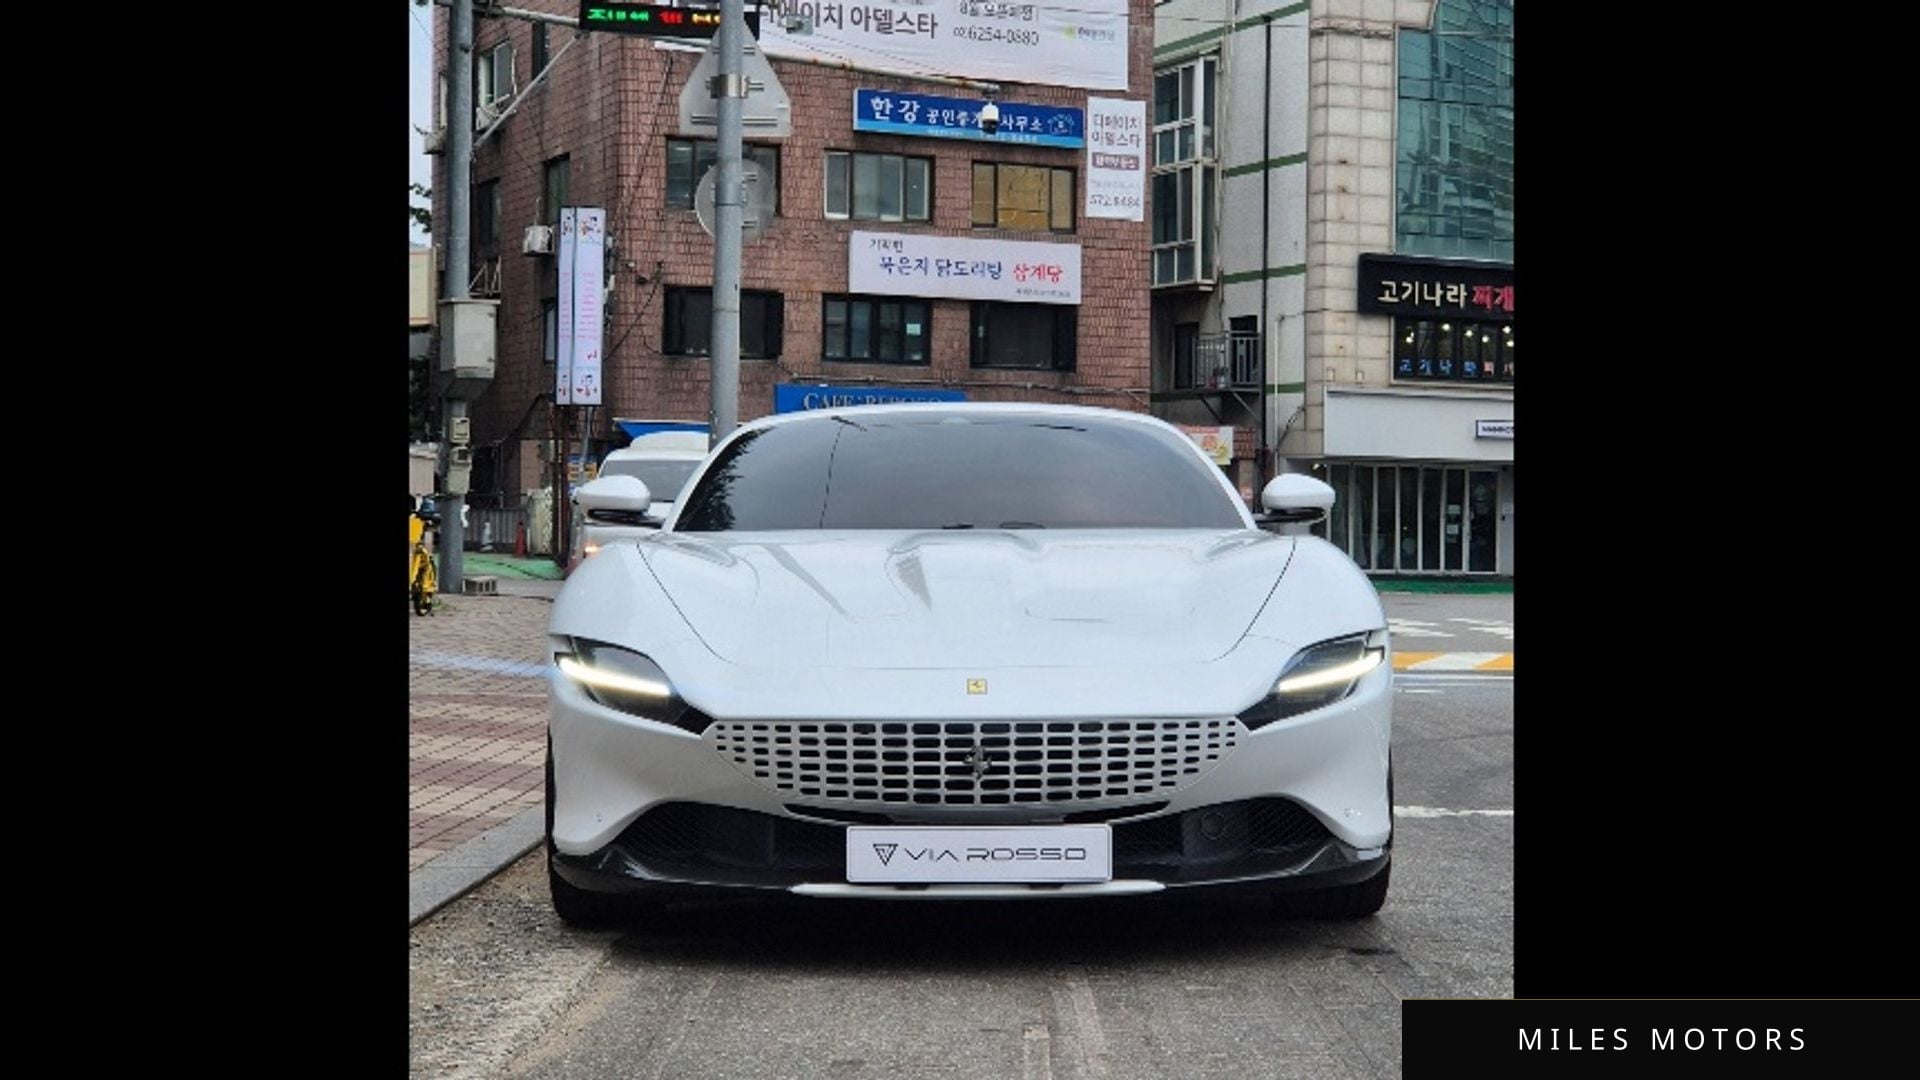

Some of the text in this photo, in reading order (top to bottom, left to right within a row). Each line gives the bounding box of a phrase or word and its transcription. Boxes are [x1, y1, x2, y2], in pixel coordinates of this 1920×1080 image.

[850, 5, 939, 39] 아델스타
[926, 108, 1044, 133] 공인중개사무소
[1377, 280, 1467, 309] 고기나라
[904, 847, 1087, 862] VIA ROSSO
